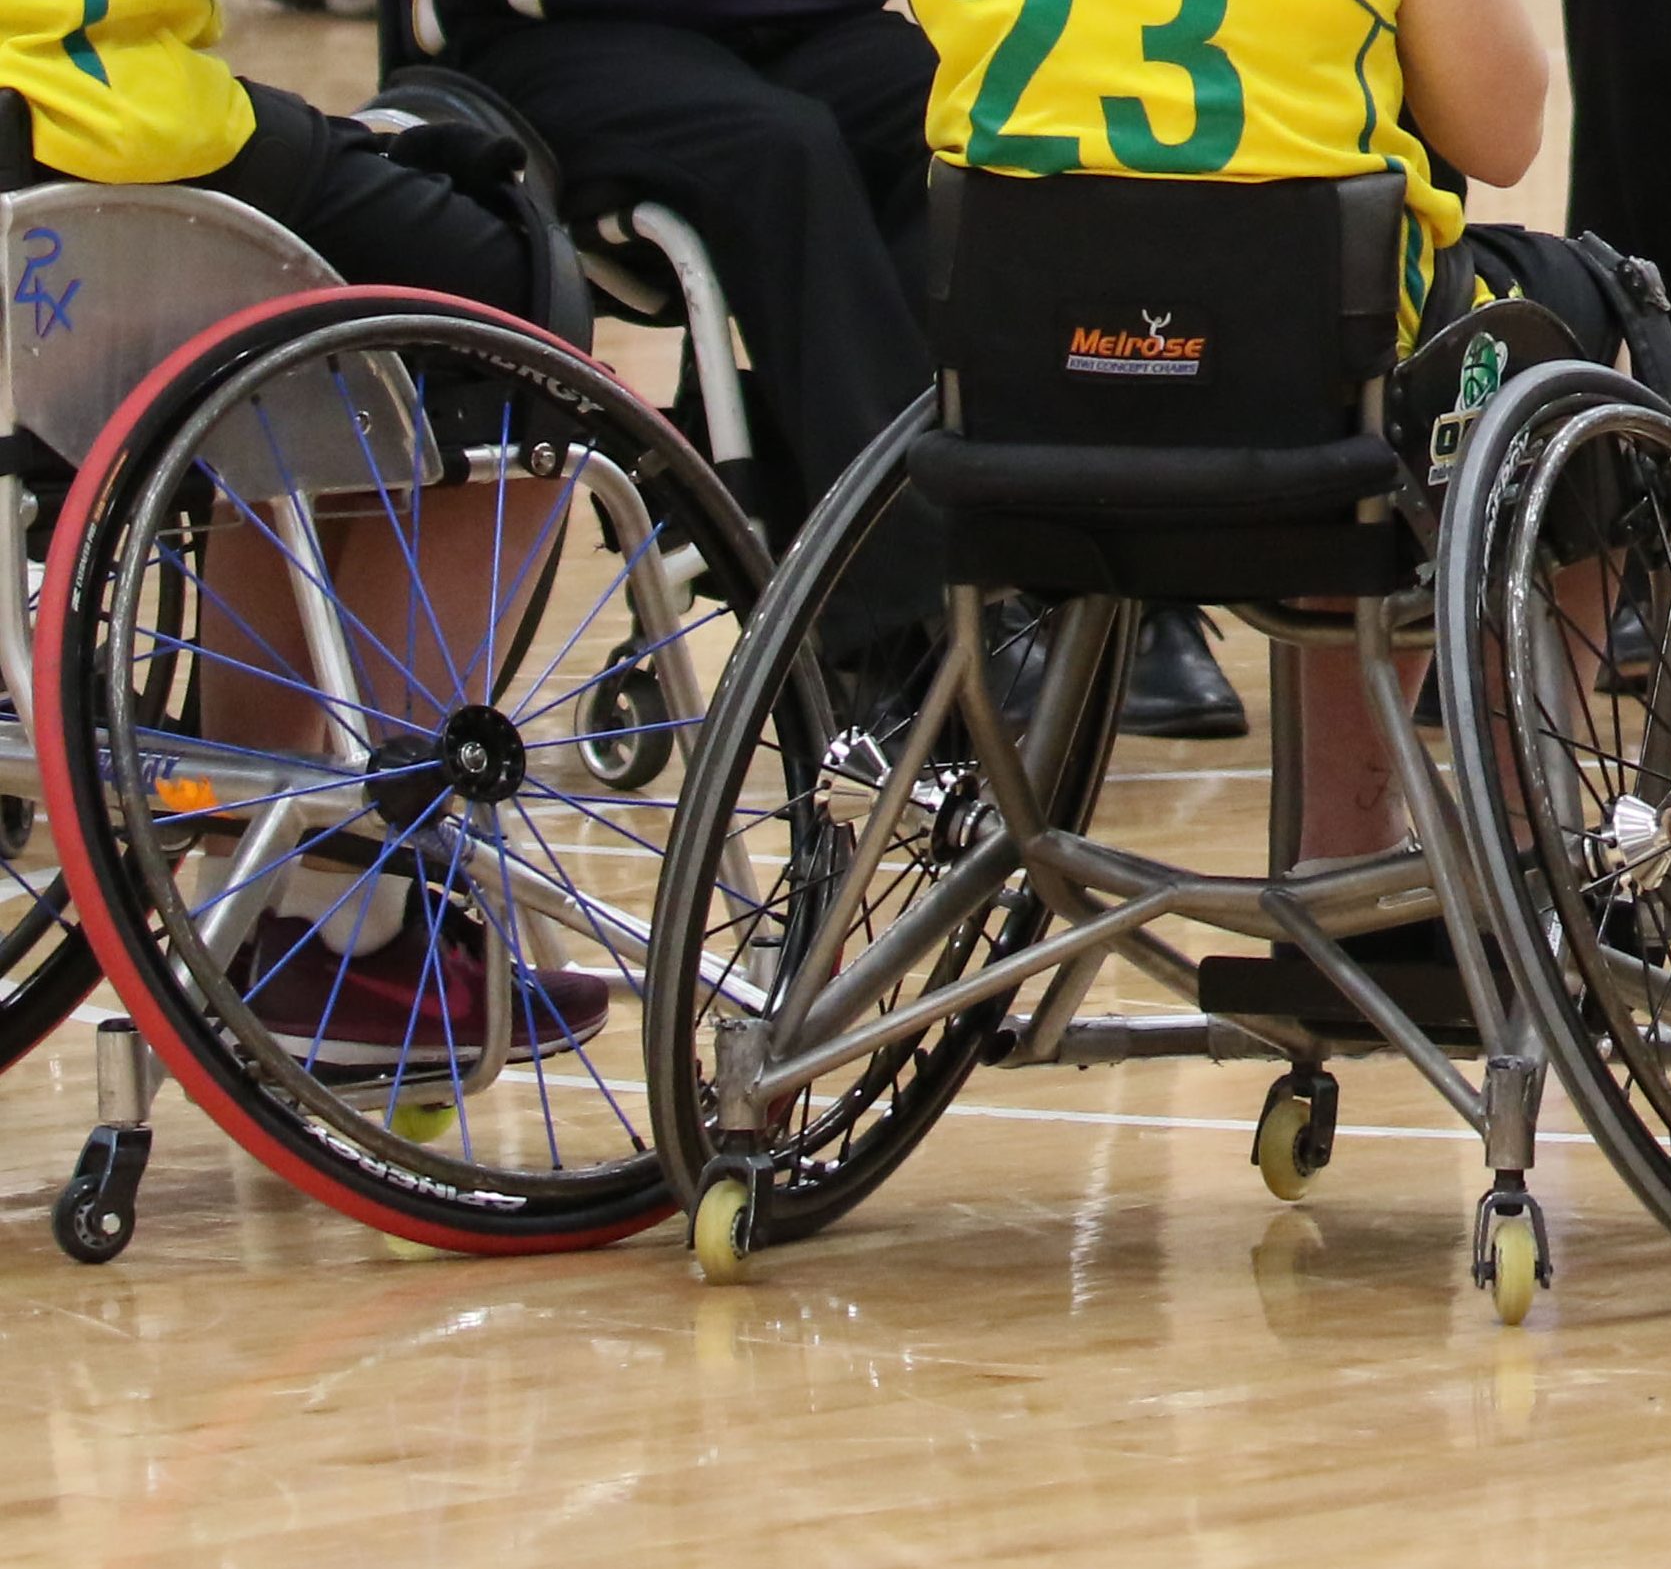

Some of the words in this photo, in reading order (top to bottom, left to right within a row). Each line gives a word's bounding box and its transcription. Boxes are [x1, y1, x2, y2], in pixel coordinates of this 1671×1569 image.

[1071, 327, 1206, 359] Melrose
[1096, 358, 1148, 373] CONCEPT
[1152, 361, 1196, 373] CHAIRS
